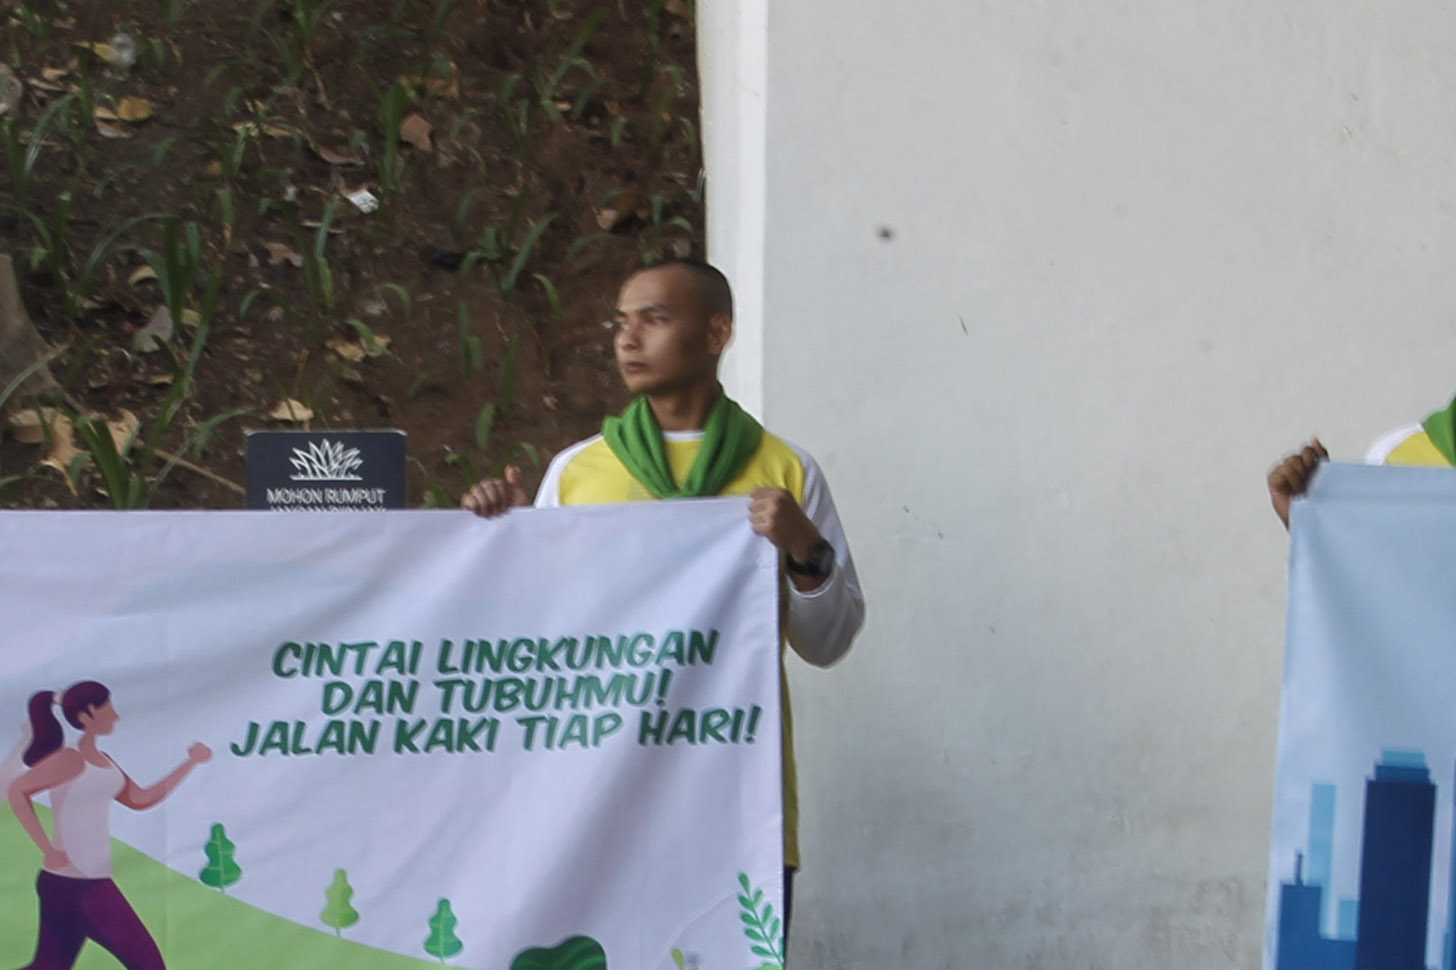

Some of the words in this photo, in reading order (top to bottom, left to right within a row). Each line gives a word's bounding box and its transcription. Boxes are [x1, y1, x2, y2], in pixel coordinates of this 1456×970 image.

[266, 488, 323, 504] MOHON
[325, 488, 387, 504] RUMPUT
[272, 639, 423, 679] CINTAI
[436, 628, 720, 675] LINGKUNGAN
[321, 679, 419, 716] DAN
[433, 668, 673, 713] TUBUHMU!
[230, 718, 381, 758] JALAN
[393, 717, 500, 755] KAKI
[515, 712, 623, 751] TIAP
[638, 705, 762, 748] HARI!
